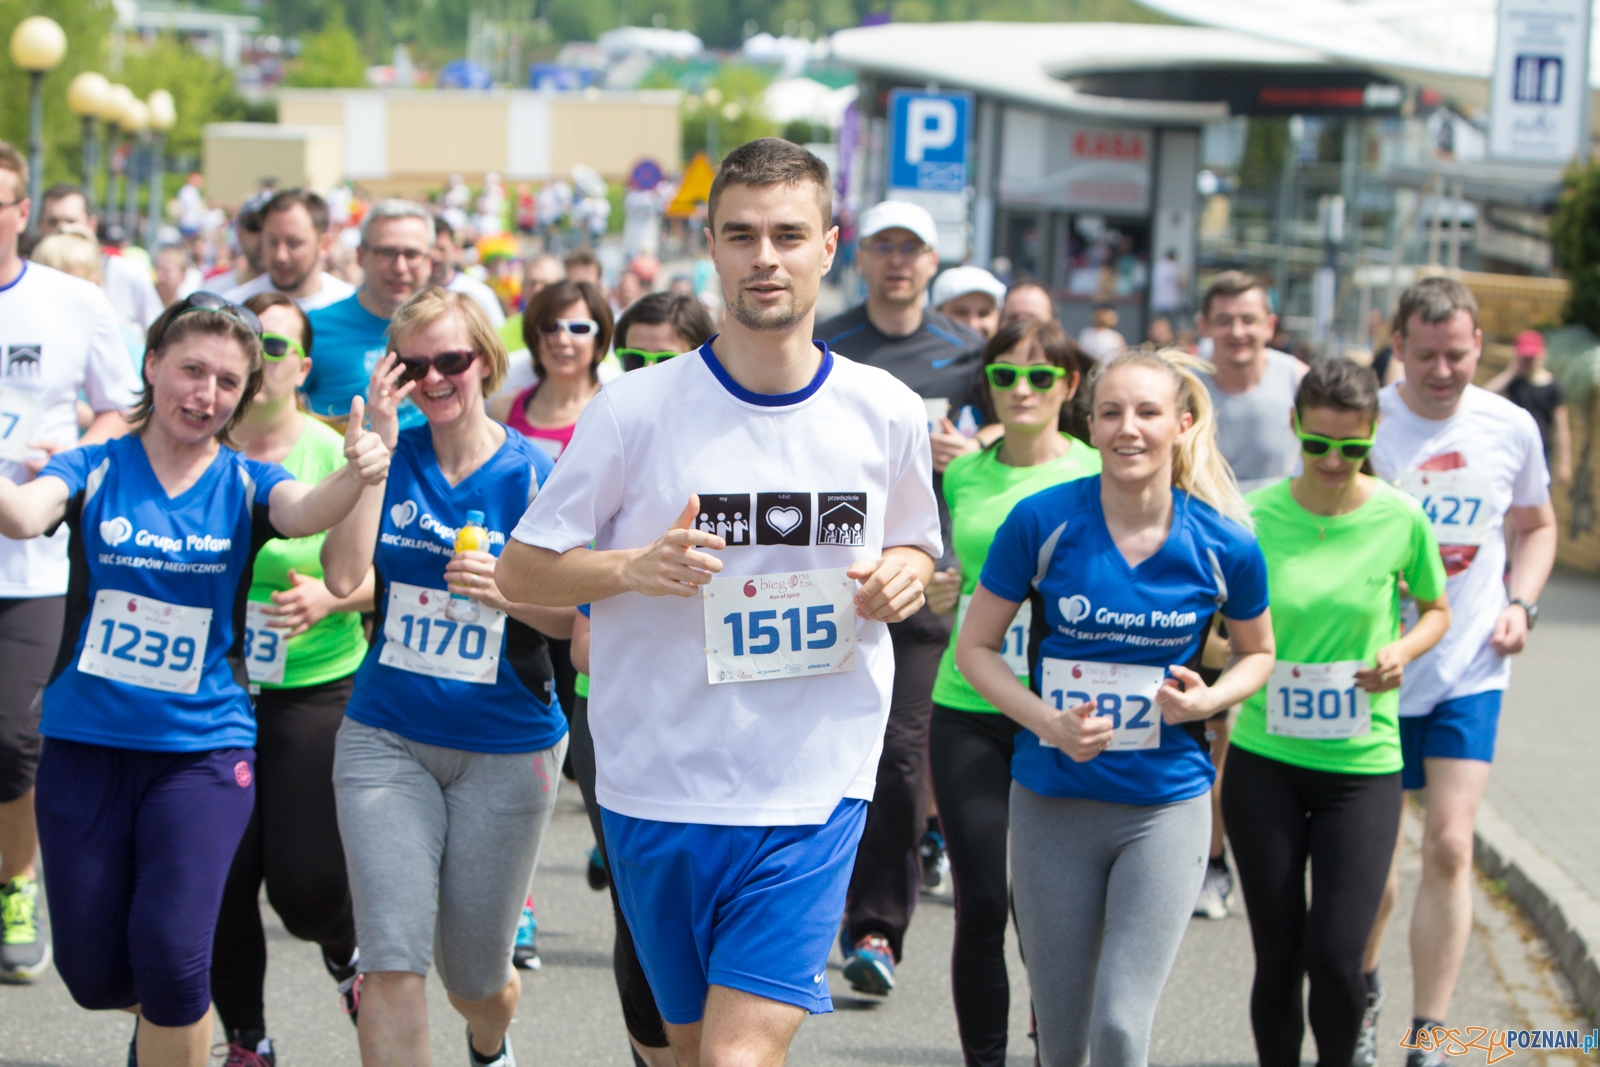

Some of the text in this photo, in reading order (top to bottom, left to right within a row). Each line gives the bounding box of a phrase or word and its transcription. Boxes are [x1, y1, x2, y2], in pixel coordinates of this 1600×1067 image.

[906, 97, 958, 165] P
[828, 494, 860, 502] przedszkole
[1421, 495, 1482, 525] 427
[135, 529, 231, 553] Grupa Pofam
[400, 537, 441, 554] SKLEPÓW
[115, 555, 163, 570] SKLEPÓW
[163, 561, 227, 574] MEDYCZNYCH
[760, 578, 787, 593] bieg
[800, 579, 815, 588] tak
[723, 604, 837, 656] 1515
[1095, 607, 1197, 630] Grupa Pofam
[100, 618, 196, 672] 1239
[400, 614, 487, 660] 1170
[1076, 630, 1126, 643] SKLEPÓW
[1125, 633, 1193, 647] MEDYCZNYCH
[1278, 686, 1356, 719] 1301
